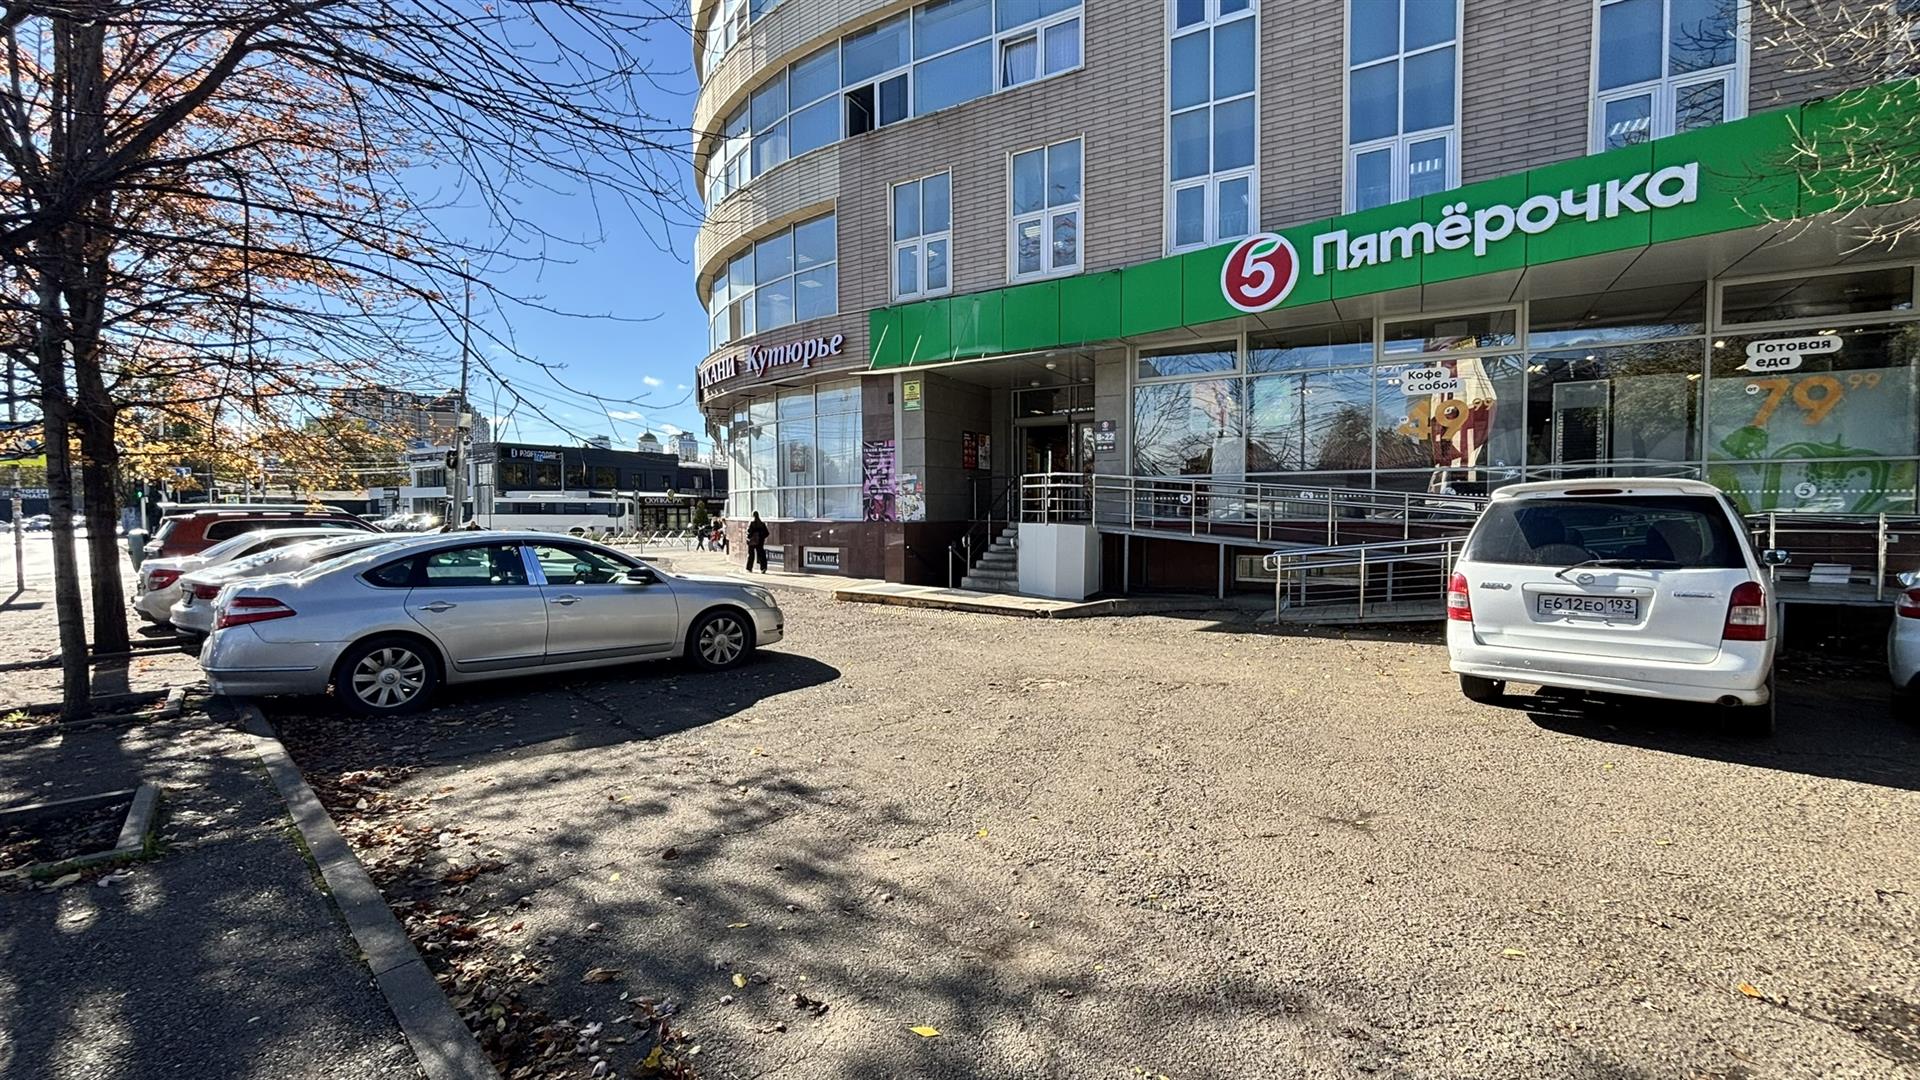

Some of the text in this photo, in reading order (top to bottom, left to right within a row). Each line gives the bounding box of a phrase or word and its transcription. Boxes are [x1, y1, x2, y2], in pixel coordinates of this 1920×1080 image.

[1240, 161, 1699, 298] 5 Пятёрочка
[1756, 339, 1831, 353] Готовая
[699, 334, 843, 389] ТКАНИ Кутюрье
[1755, 357, 1790, 368] еда
[1407, 369, 1442, 380] Кофе
[1418, 380, 1458, 391] собой
[1751, 375, 1844, 427] 79
[1847, 373, 1881, 390] 99
[1393, 399, 1469, 441] 49
[1607, 599, 1633, 610] 193
